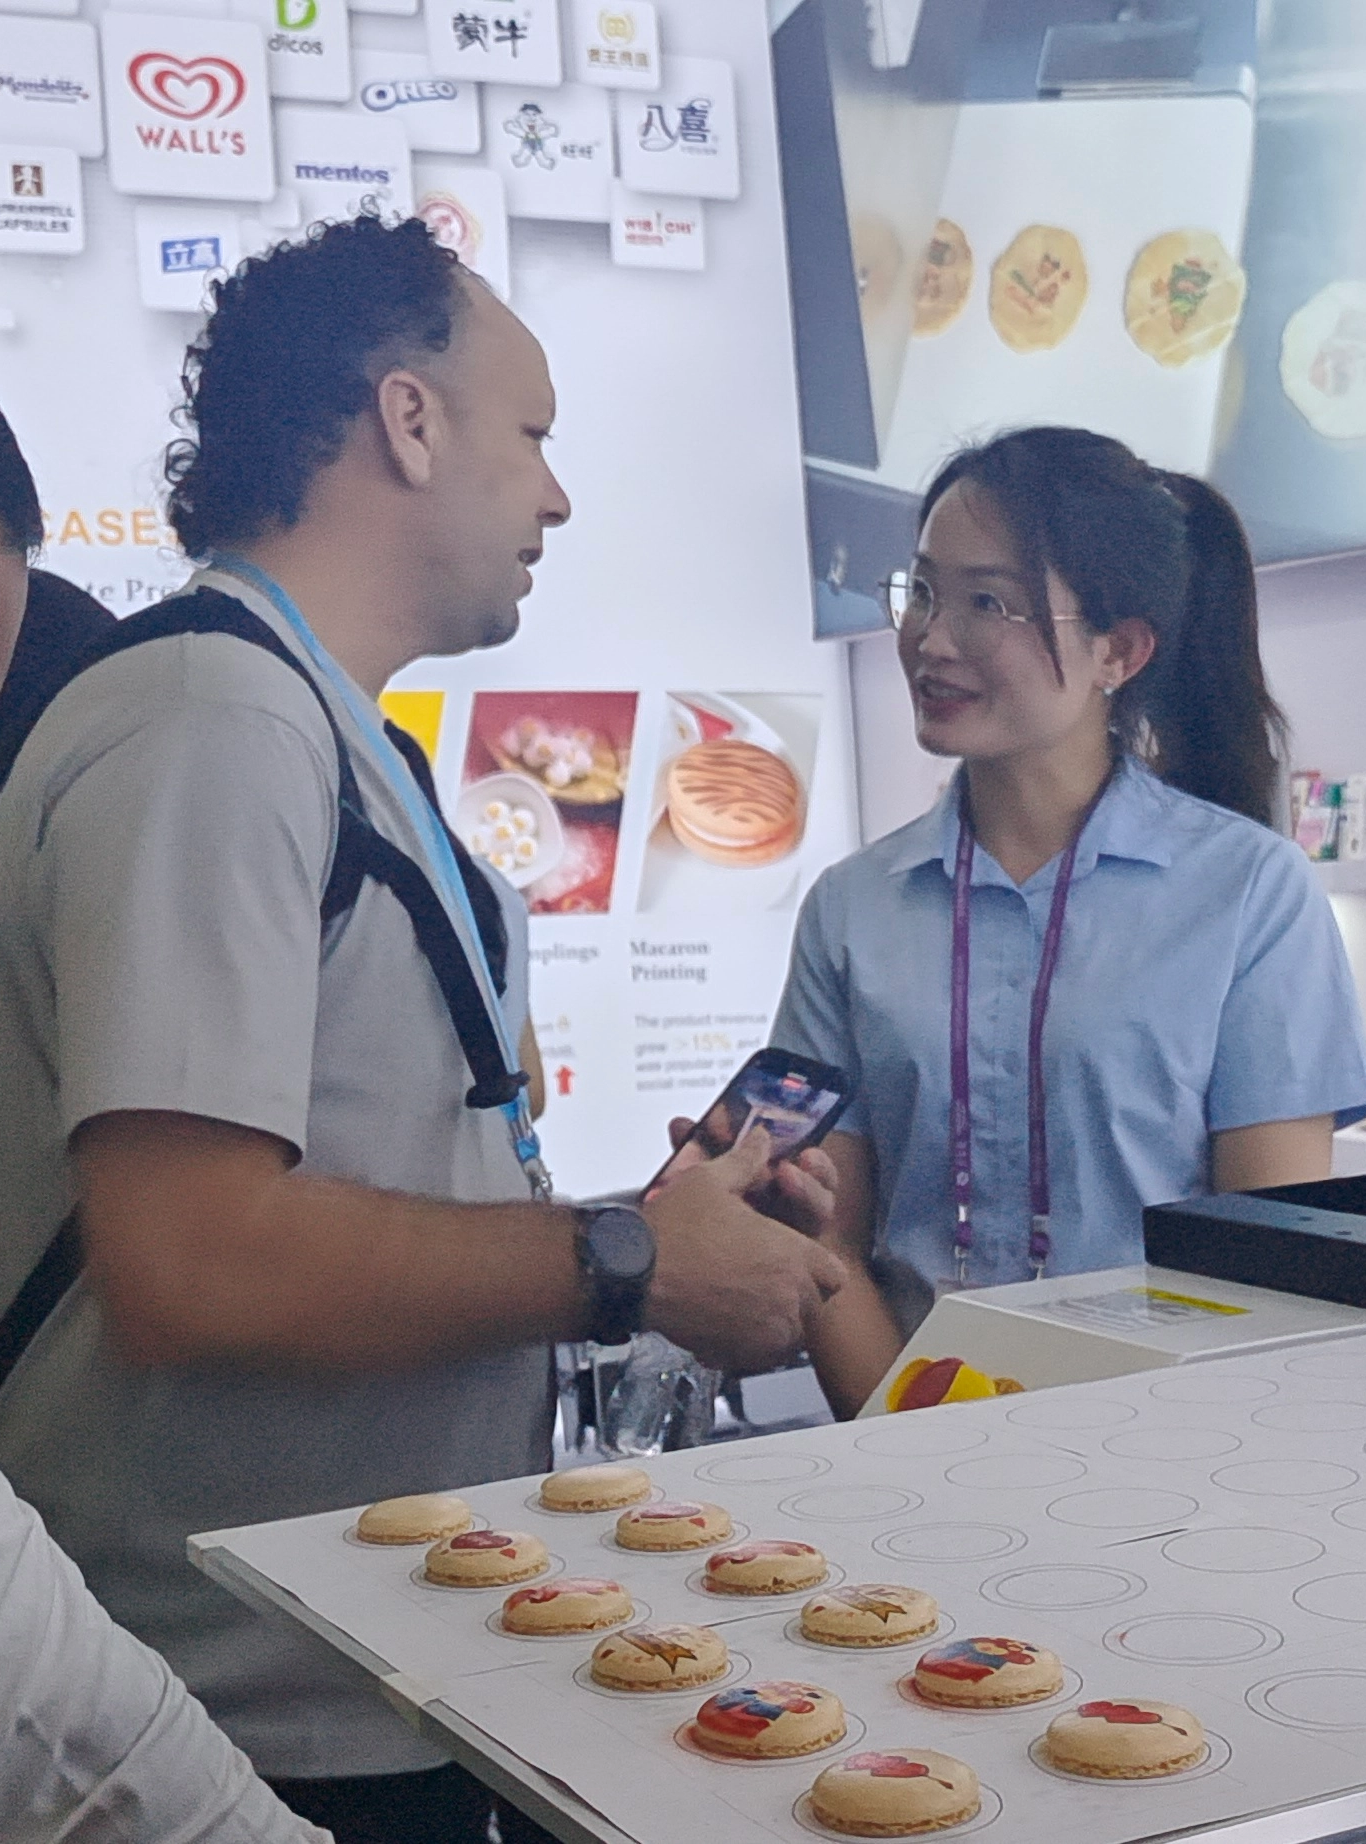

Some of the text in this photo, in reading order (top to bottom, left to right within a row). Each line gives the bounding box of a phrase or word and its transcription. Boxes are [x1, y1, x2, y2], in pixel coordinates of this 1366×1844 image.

[453, 13, 528, 58] 蒙牛
[362, 80, 457, 112] OREO
[639, 103, 712, 144] 八喜
[137, 125, 247, 157] WALL'S
[295, 161, 390, 184] mentos
[42, 508, 178, 545] ASE
[629, 941, 709, 956] Macaron
[631, 965, 708, 984] Printing
